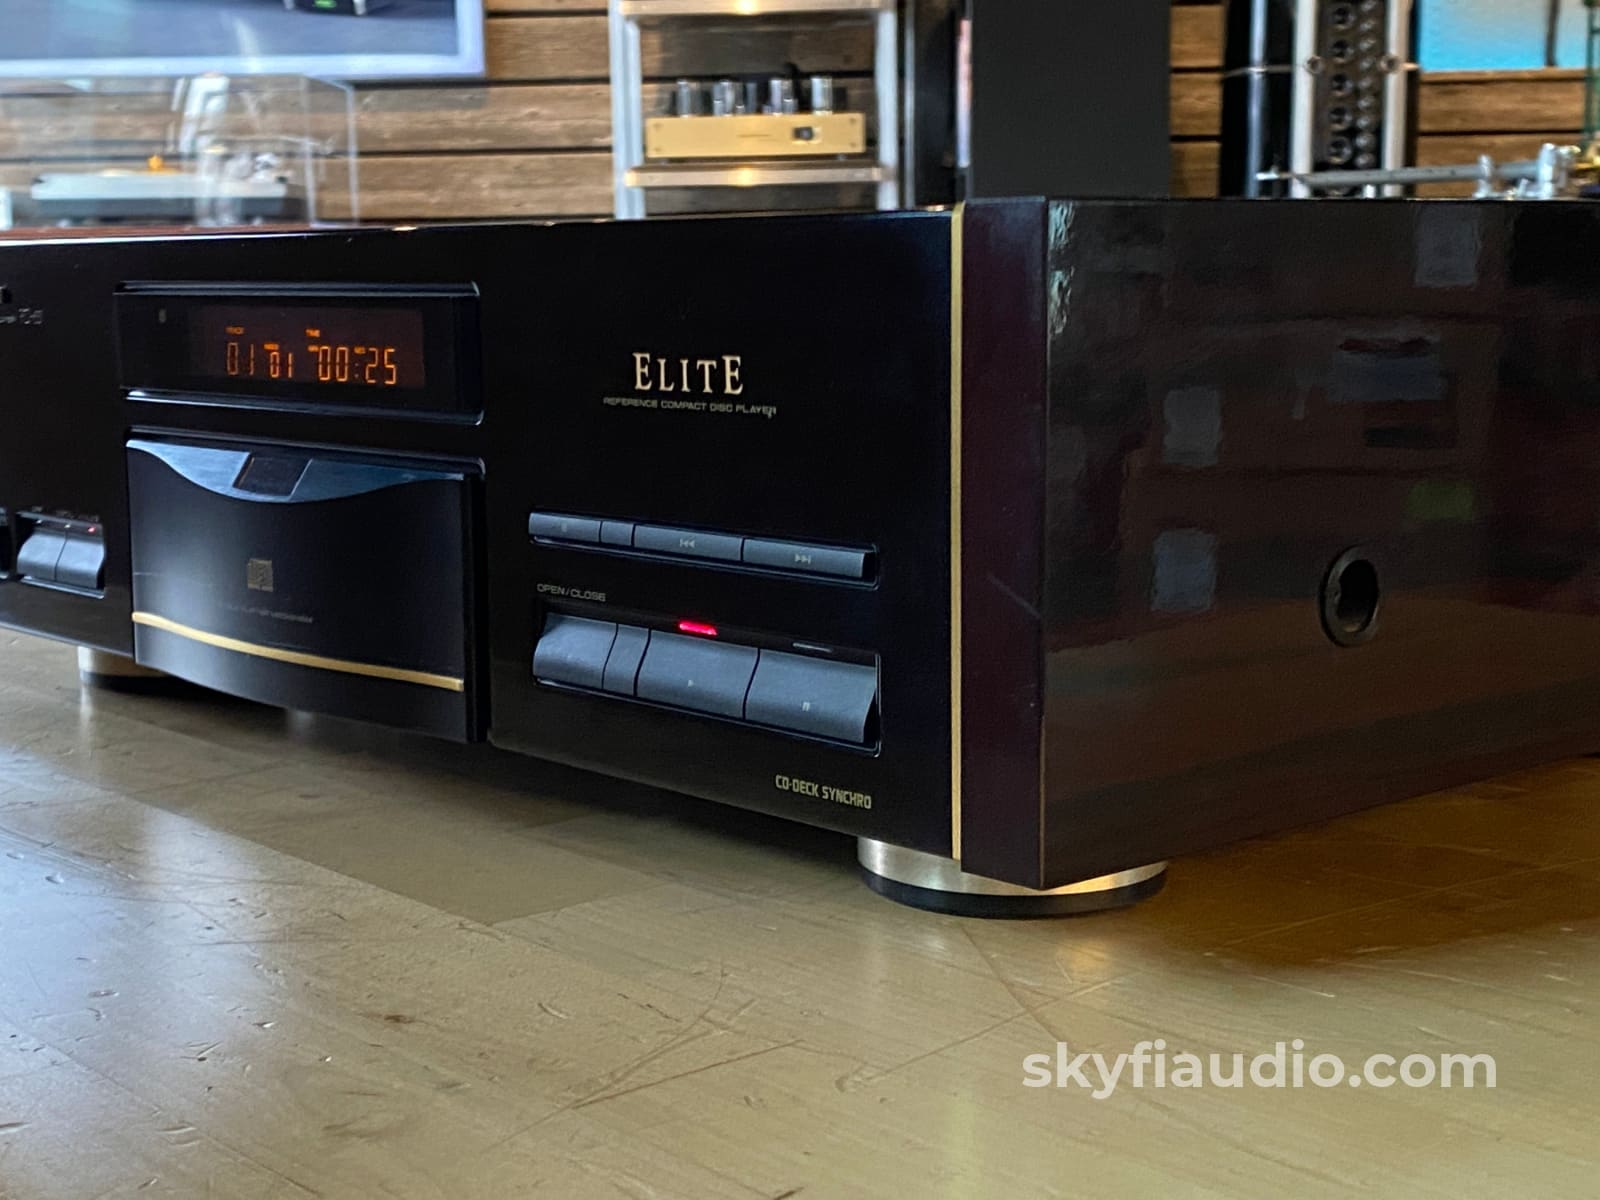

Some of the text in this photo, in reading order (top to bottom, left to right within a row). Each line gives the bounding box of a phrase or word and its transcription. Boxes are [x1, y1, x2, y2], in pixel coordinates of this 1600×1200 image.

[226, 342, 397, 385] 01 01 00:25
[660, 400, 707, 411] COMPACT
[709, 403, 733, 412] DISC
[821, 785, 872, 809] SYNCHRO
